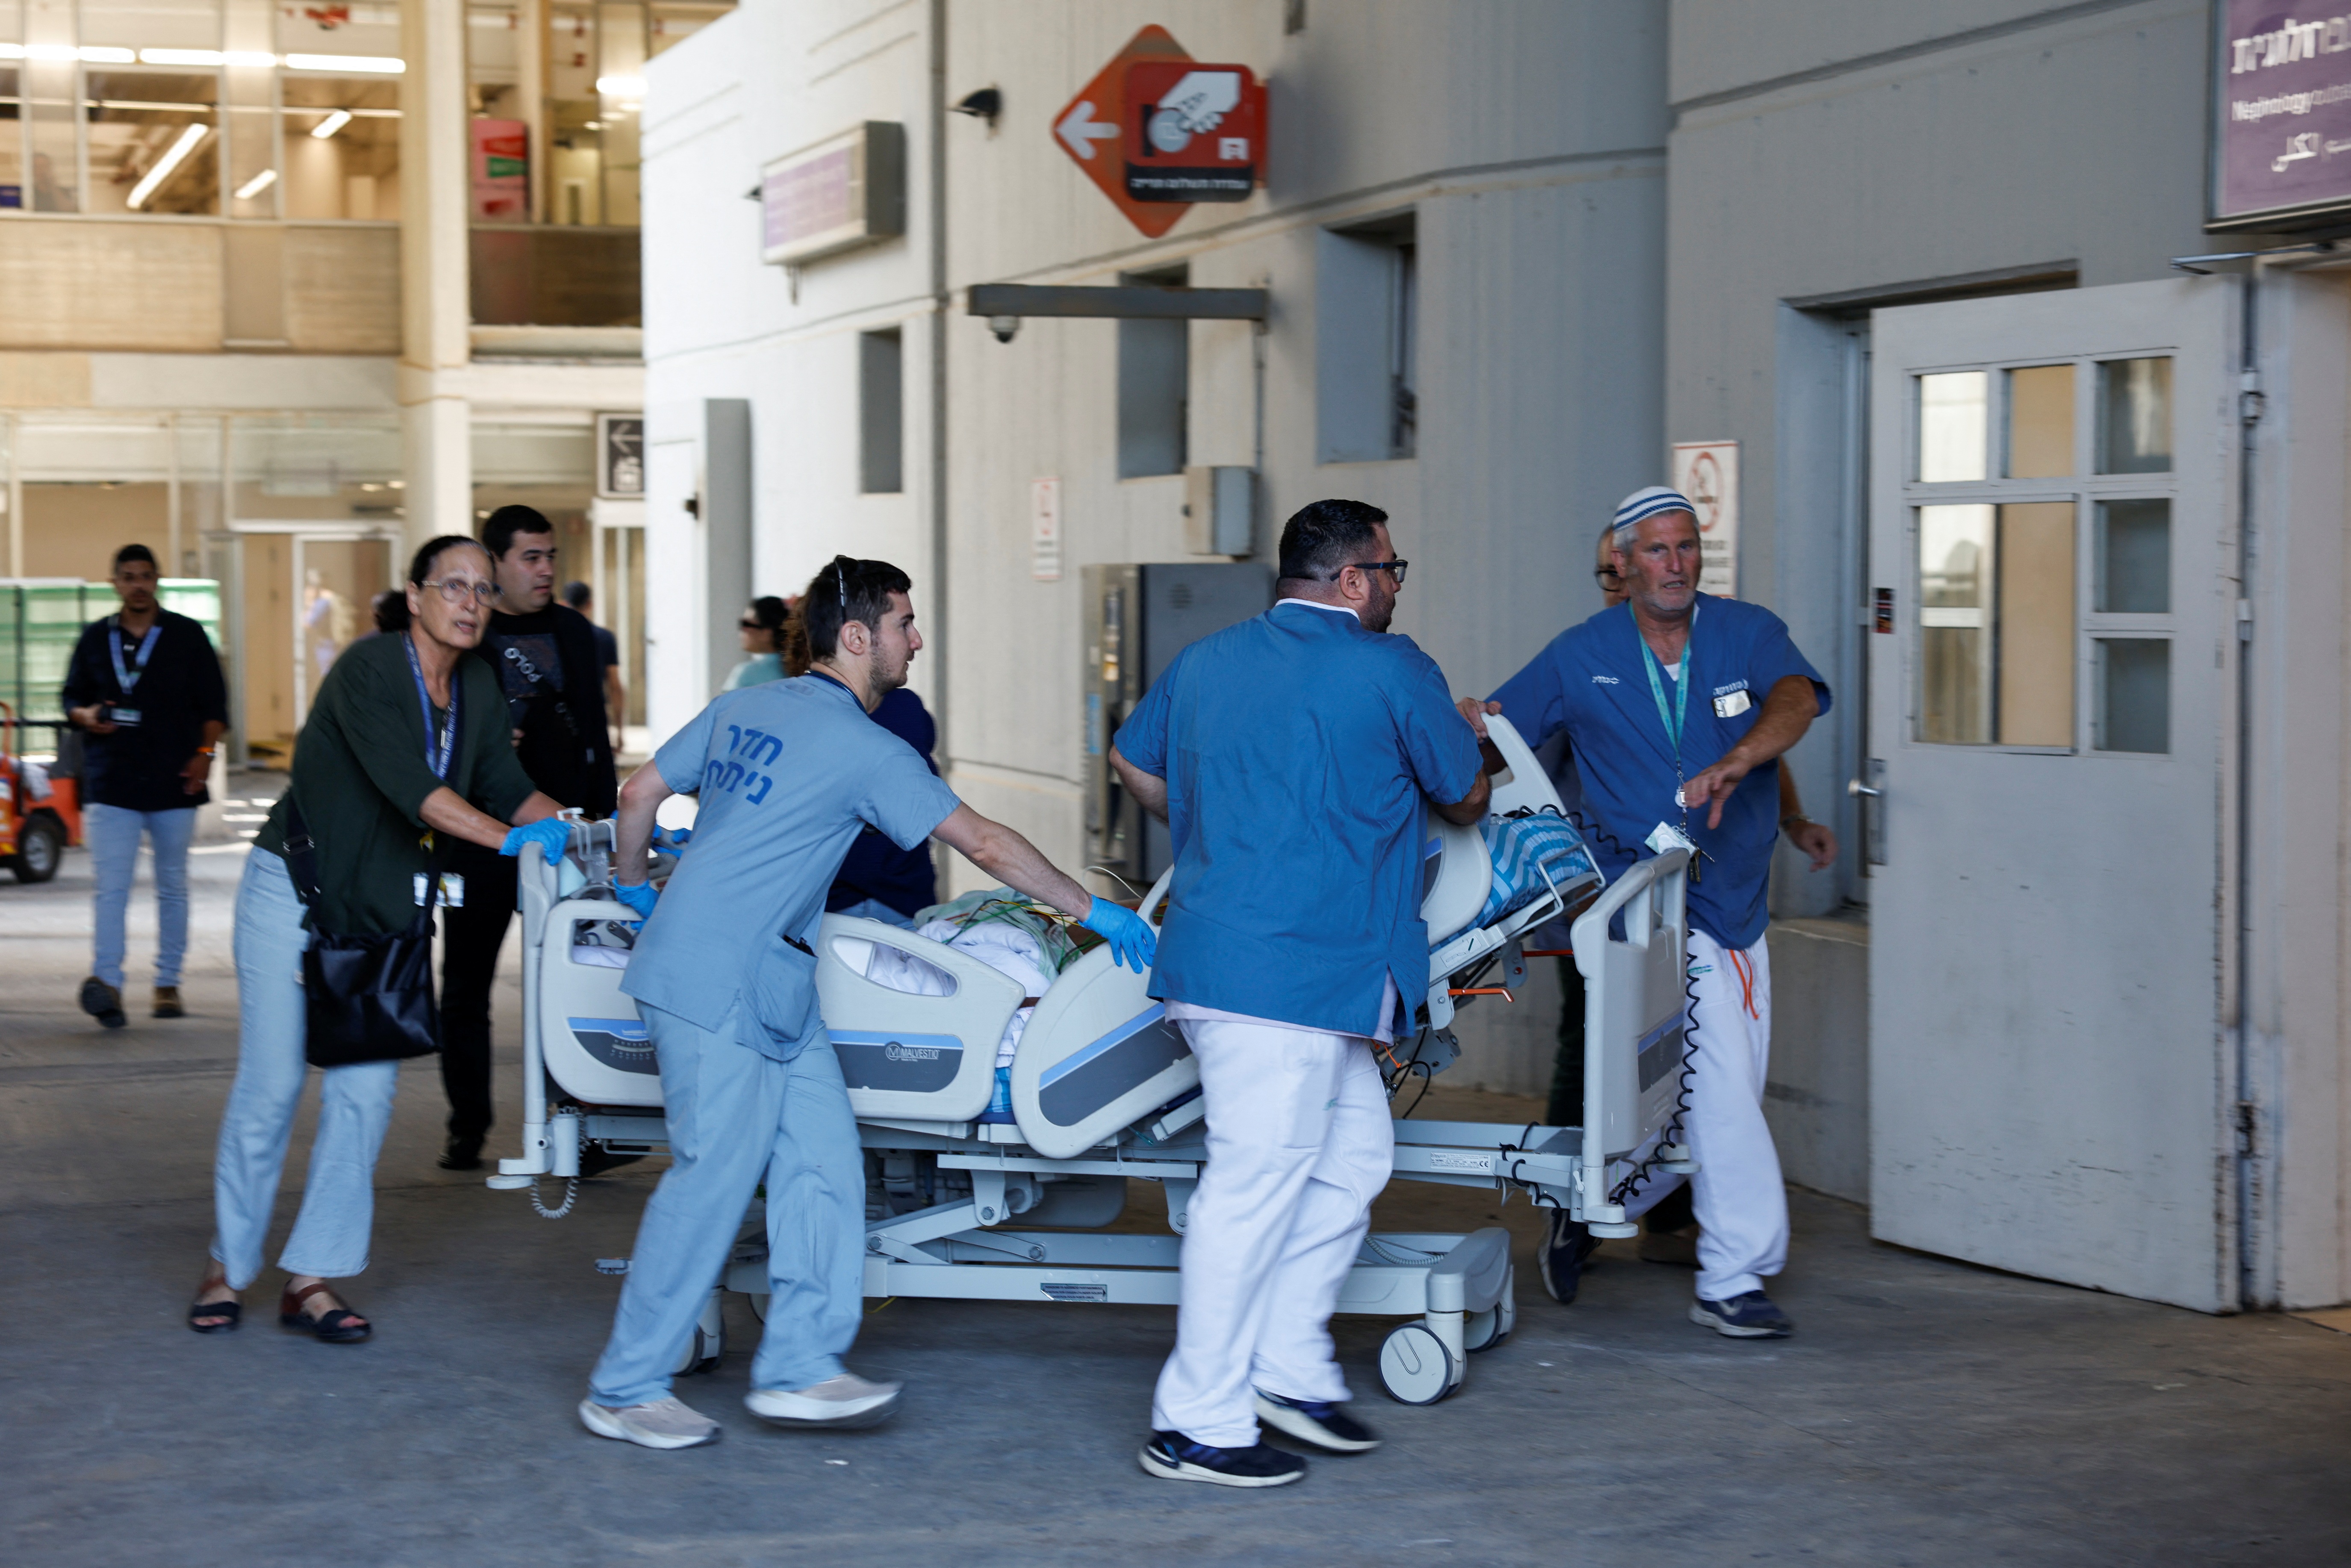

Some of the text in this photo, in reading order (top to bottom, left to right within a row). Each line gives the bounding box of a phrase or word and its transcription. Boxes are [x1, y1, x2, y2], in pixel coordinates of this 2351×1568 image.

[2232, 91, 2312, 123] Nephrology
[728, 725, 783, 766] חדר
[901, 1047, 939, 1058] MALVESTIO
